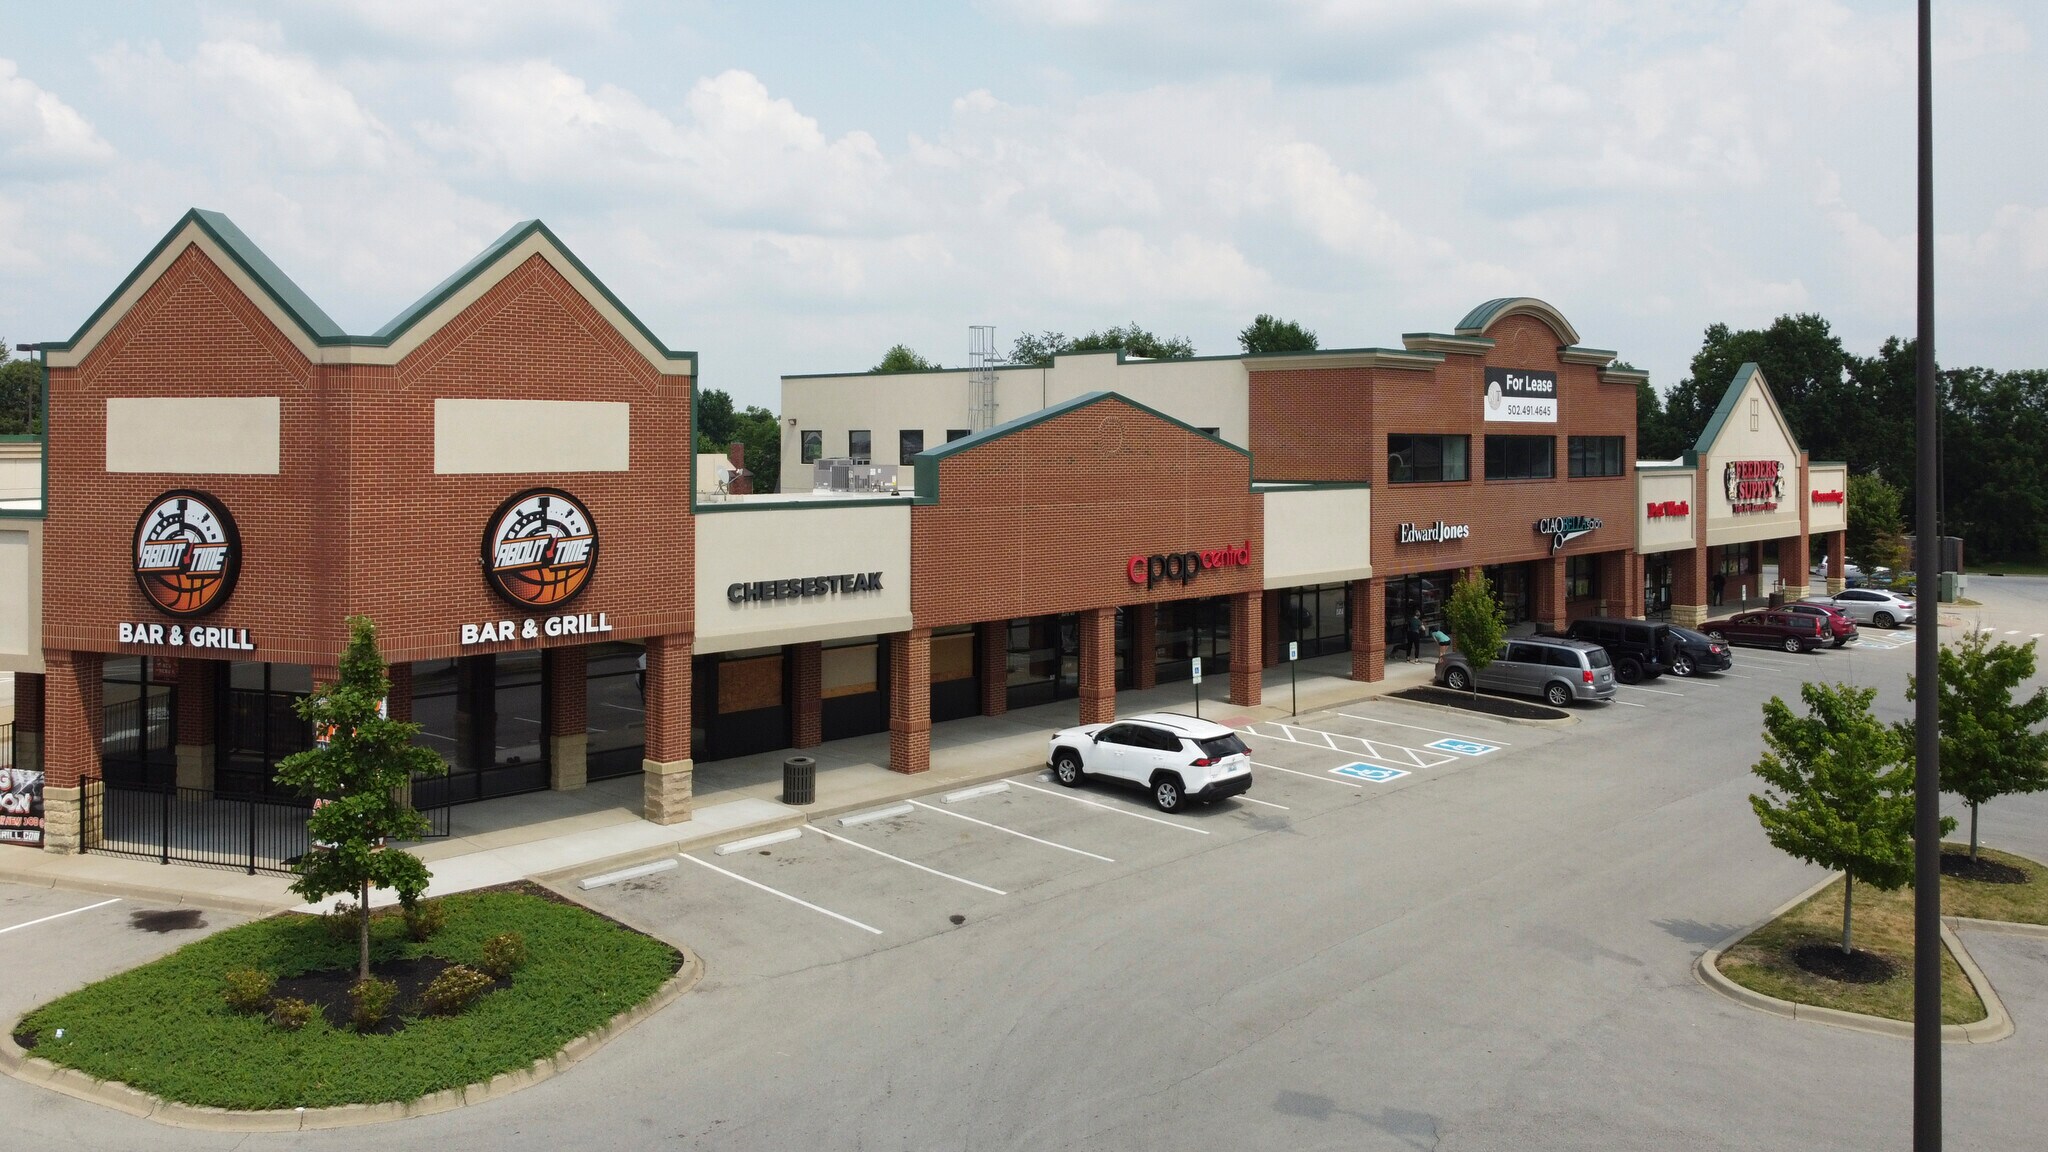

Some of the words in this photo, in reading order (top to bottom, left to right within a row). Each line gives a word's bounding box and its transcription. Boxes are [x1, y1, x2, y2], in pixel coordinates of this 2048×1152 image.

[1506, 374, 1524, 391] For
[1525, 376, 1553, 392] Lease
[1508, 404, 1551, 416] 502.491.4645
[1736, 461, 1777, 480] FEEDERS
[1739, 480, 1774, 499] SUPPLY
[1540, 517, 1564, 534] CIAO
[139, 543, 187, 569] ABOUT
[190, 546, 228, 572] TIME
[494, 538, 550, 568] ABOUT
[553, 538, 593, 565] TIME
[727, 571, 884, 603] CHEESESTEAK
[119, 622, 165, 645] BAR
[169, 625, 184, 646] &
[189, 626, 254, 650] GRILL
[461, 620, 516, 645] BAR
[521, 618, 539, 639] &
[544, 612, 613, 637] GRILL
[0, 793, 32, 814] ON
